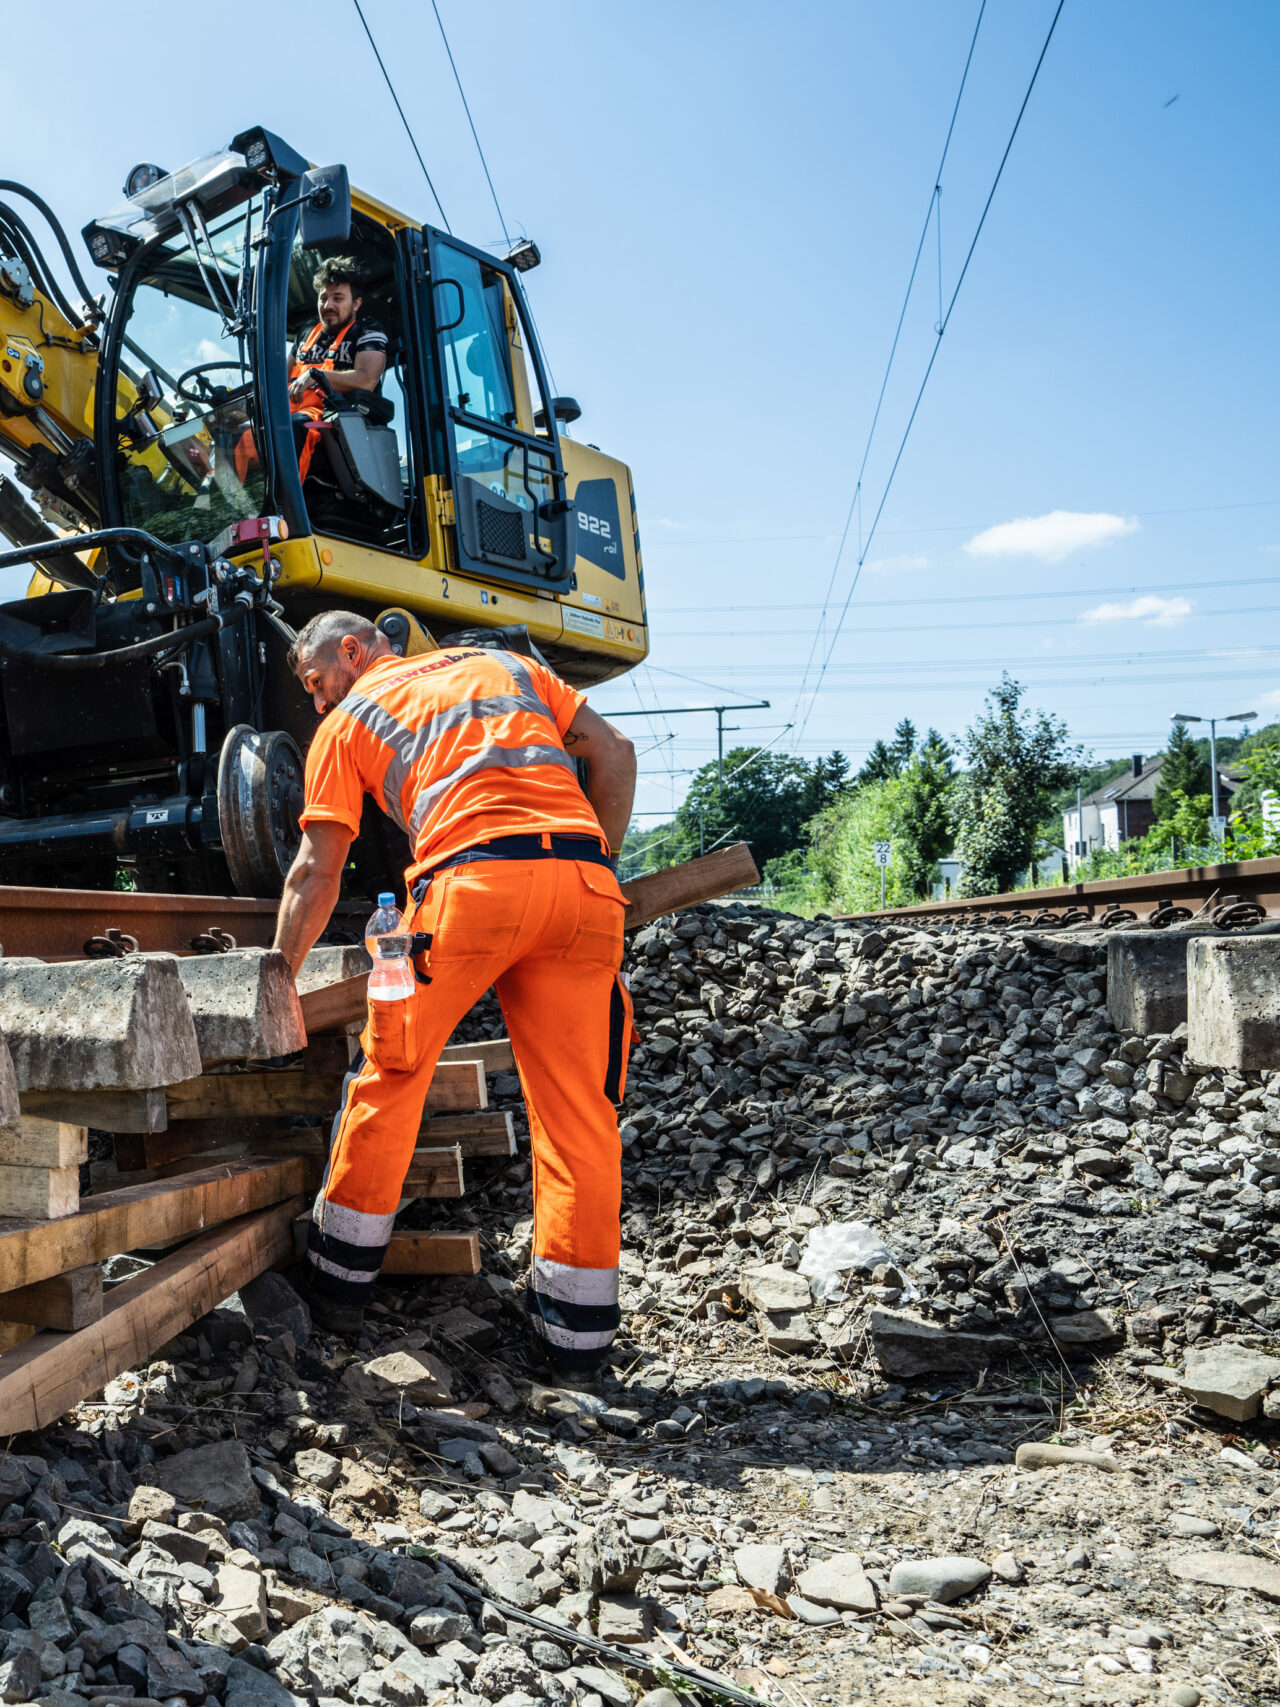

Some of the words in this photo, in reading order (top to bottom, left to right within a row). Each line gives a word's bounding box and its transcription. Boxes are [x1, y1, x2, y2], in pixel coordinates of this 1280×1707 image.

[577, 511, 611, 539] 922
[603, 541, 617, 554] rail
[442, 578, 449, 599] 2
[876, 843, 890, 853] 22
[880, 854, 887, 863] 8
